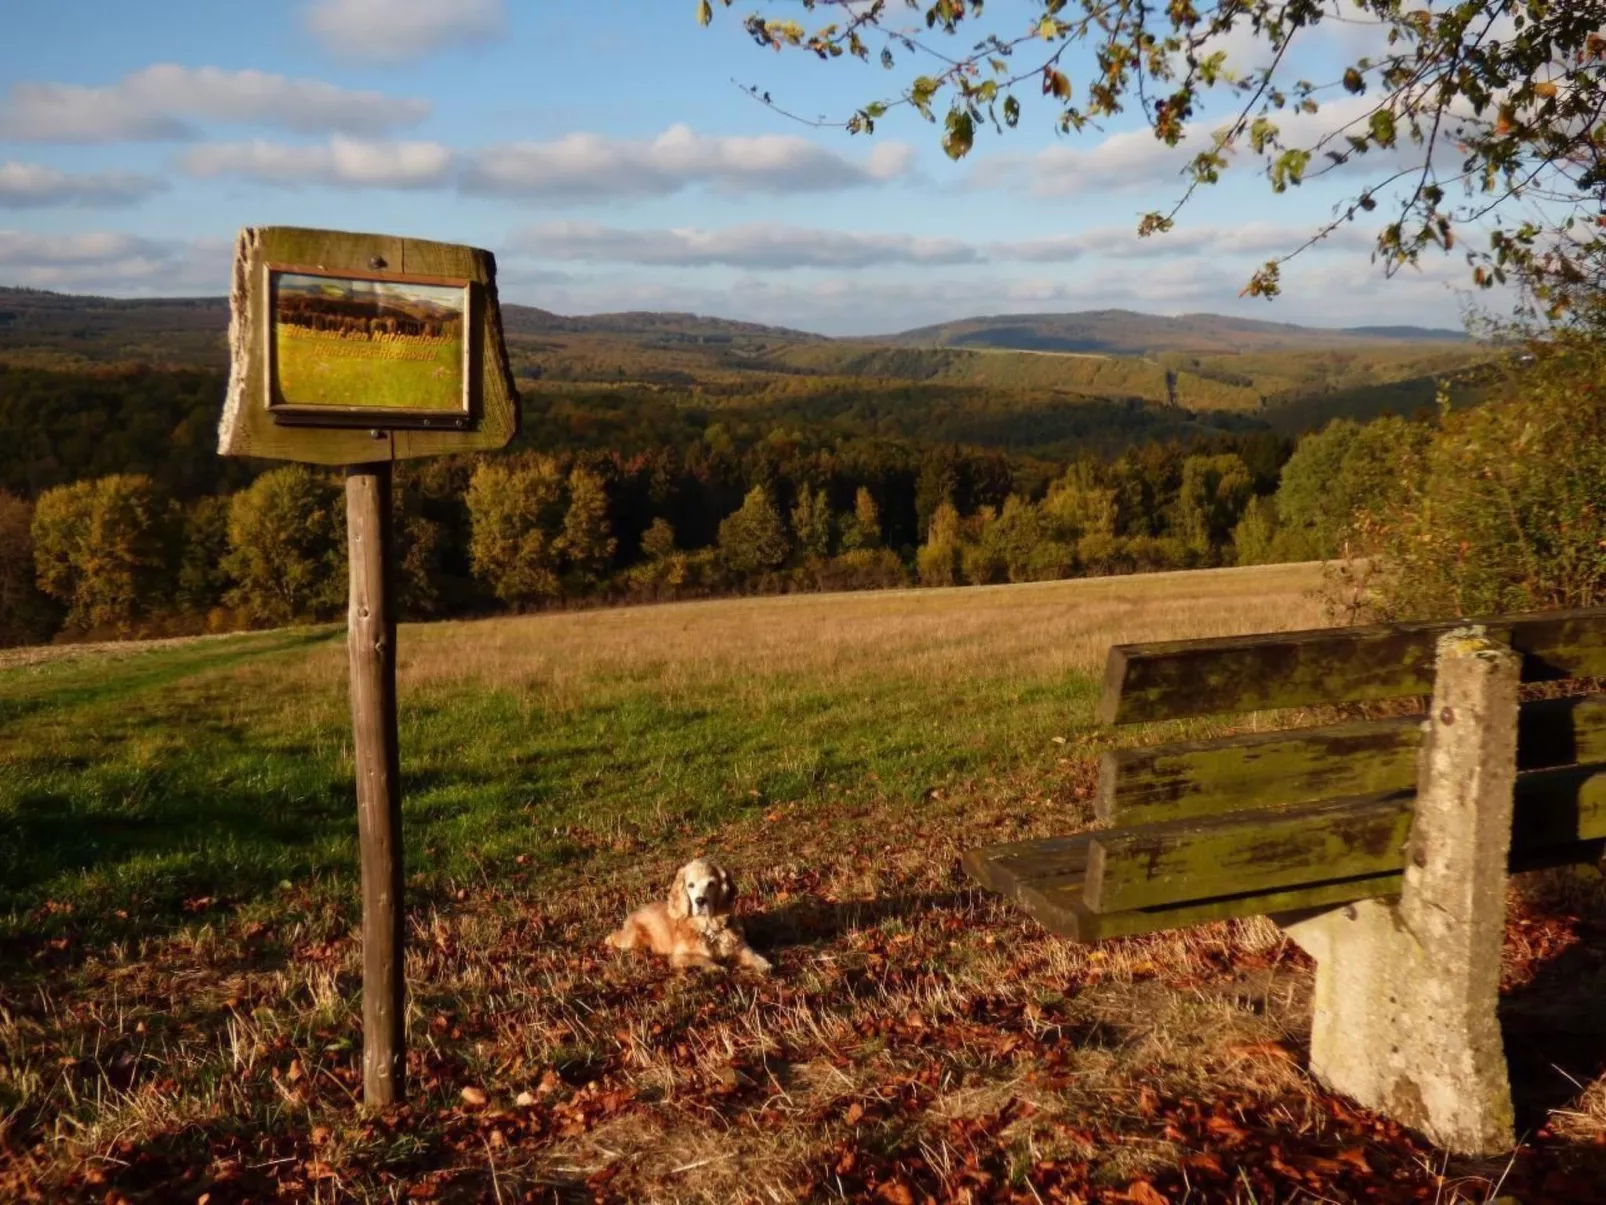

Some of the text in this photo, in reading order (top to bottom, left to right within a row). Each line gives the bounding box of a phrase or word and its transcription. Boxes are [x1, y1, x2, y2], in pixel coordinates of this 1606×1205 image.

[285, 323, 453, 346] Blick auf den Nationalpark
